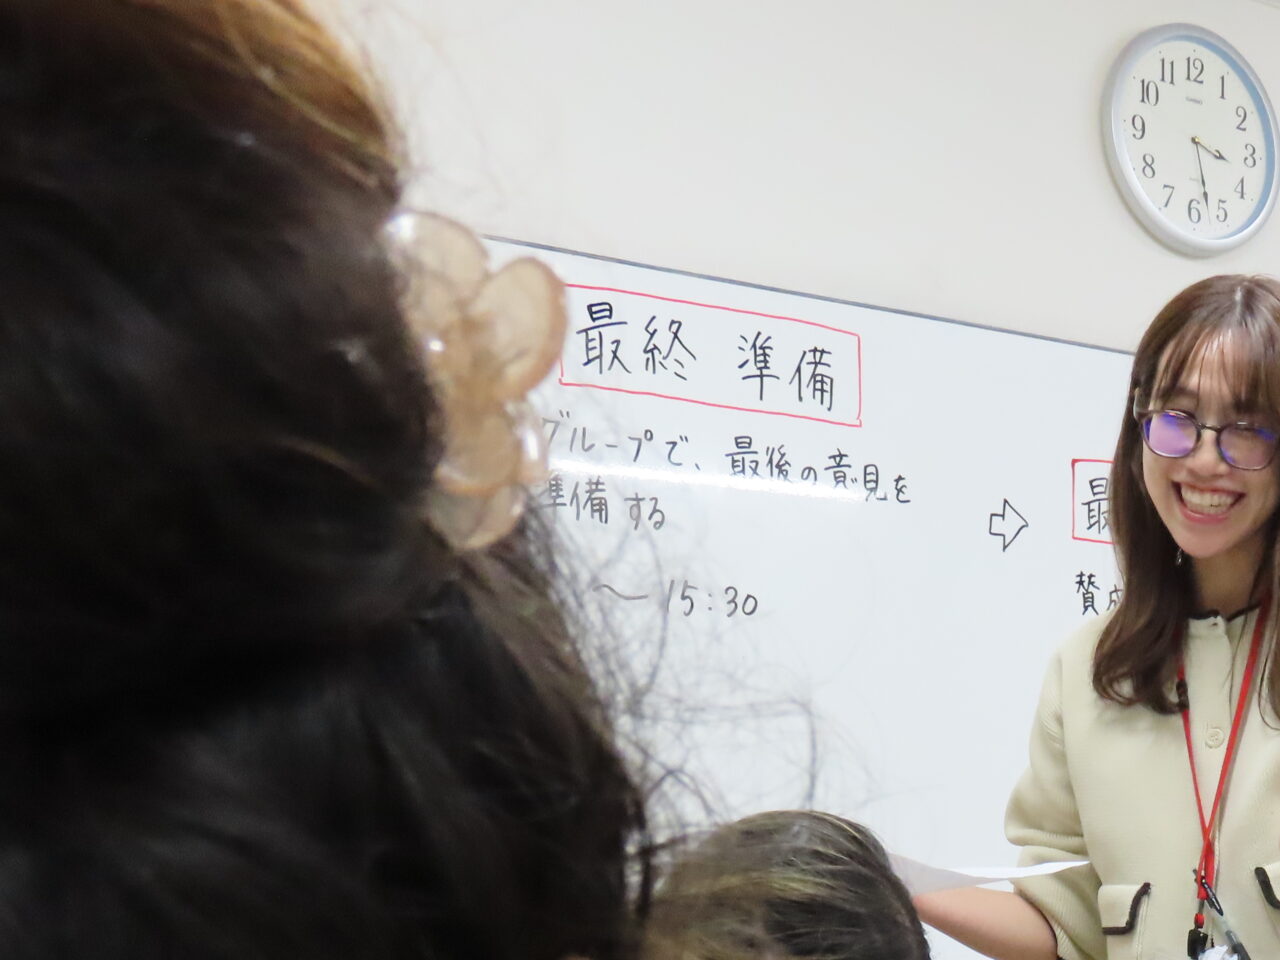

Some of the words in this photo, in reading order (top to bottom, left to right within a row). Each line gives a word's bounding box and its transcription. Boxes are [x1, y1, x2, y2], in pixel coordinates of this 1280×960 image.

[1160, 57, 1176, 85] 11
[1185, 56, 1204, 84] 12
[1140, 78, 1160, 106] 10
[1219, 75, 1227, 100] 1
[1131, 114, 1146, 140] 9
[1235, 105, 1248, 131] 2
[1142, 153, 1156, 179] 8
[1243, 143, 1257, 168] 3
[1162, 184, 1175, 208] 7
[1234, 176, 1247, 200] 4
[1187, 198, 1202, 224] 6
[1216, 199, 1228, 223] 5
[576, 301, 697, 381] 最終
[737, 330, 834, 411] 準備
